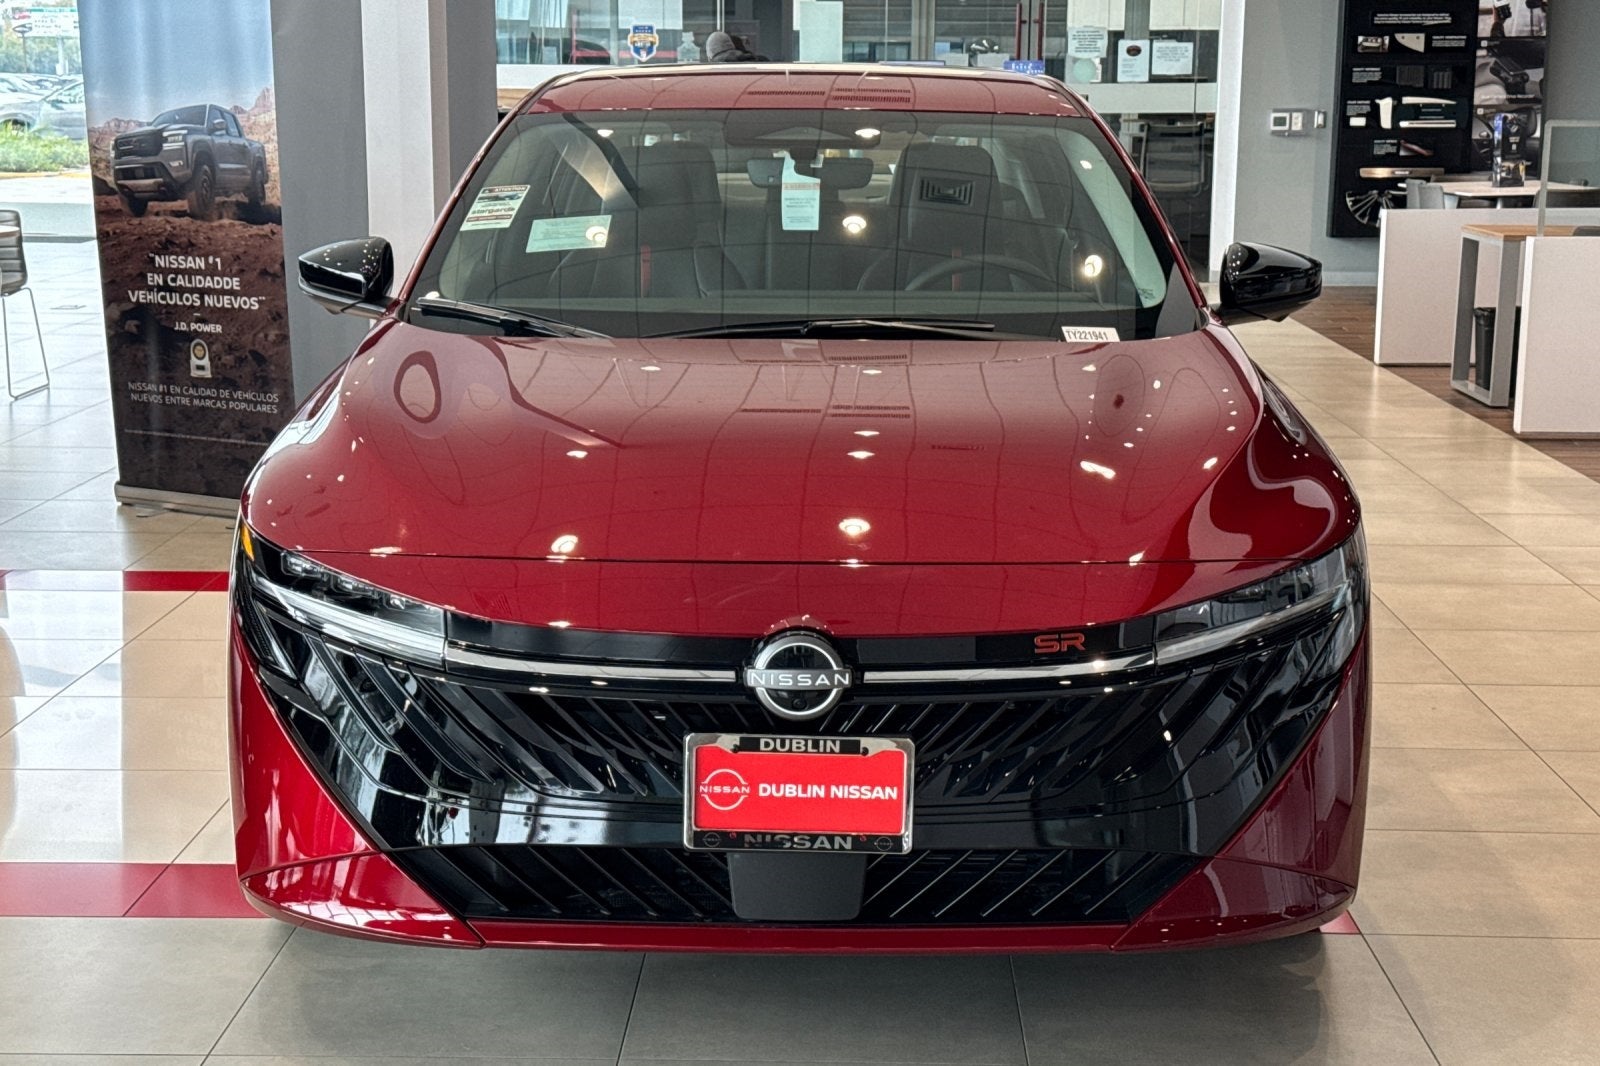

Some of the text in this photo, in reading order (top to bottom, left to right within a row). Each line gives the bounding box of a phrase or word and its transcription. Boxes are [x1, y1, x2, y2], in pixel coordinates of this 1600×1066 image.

[147, 272, 163, 286] EN
[128, 288, 200, 306] VEHÍCULOS
[174, 322, 222, 333] J.D. POWER
[1065, 330, 1109, 341] TY221941
[128, 381, 279, 403] NISSAN #1 EN CALIDAD DE VEHÍCULOS
[130, 393, 278, 414] NUEVOS ENTRE MARCAS POPULARES
[1034, 633, 1086, 653] SR
[751, 672, 849, 686] NISSAN
[759, 738, 840, 753] DUBLIN
[699, 785, 750, 793] NISSAN
[758, 783, 898, 800] DUBLIN NISSAN
[744, 834, 852, 850] NISSAN
